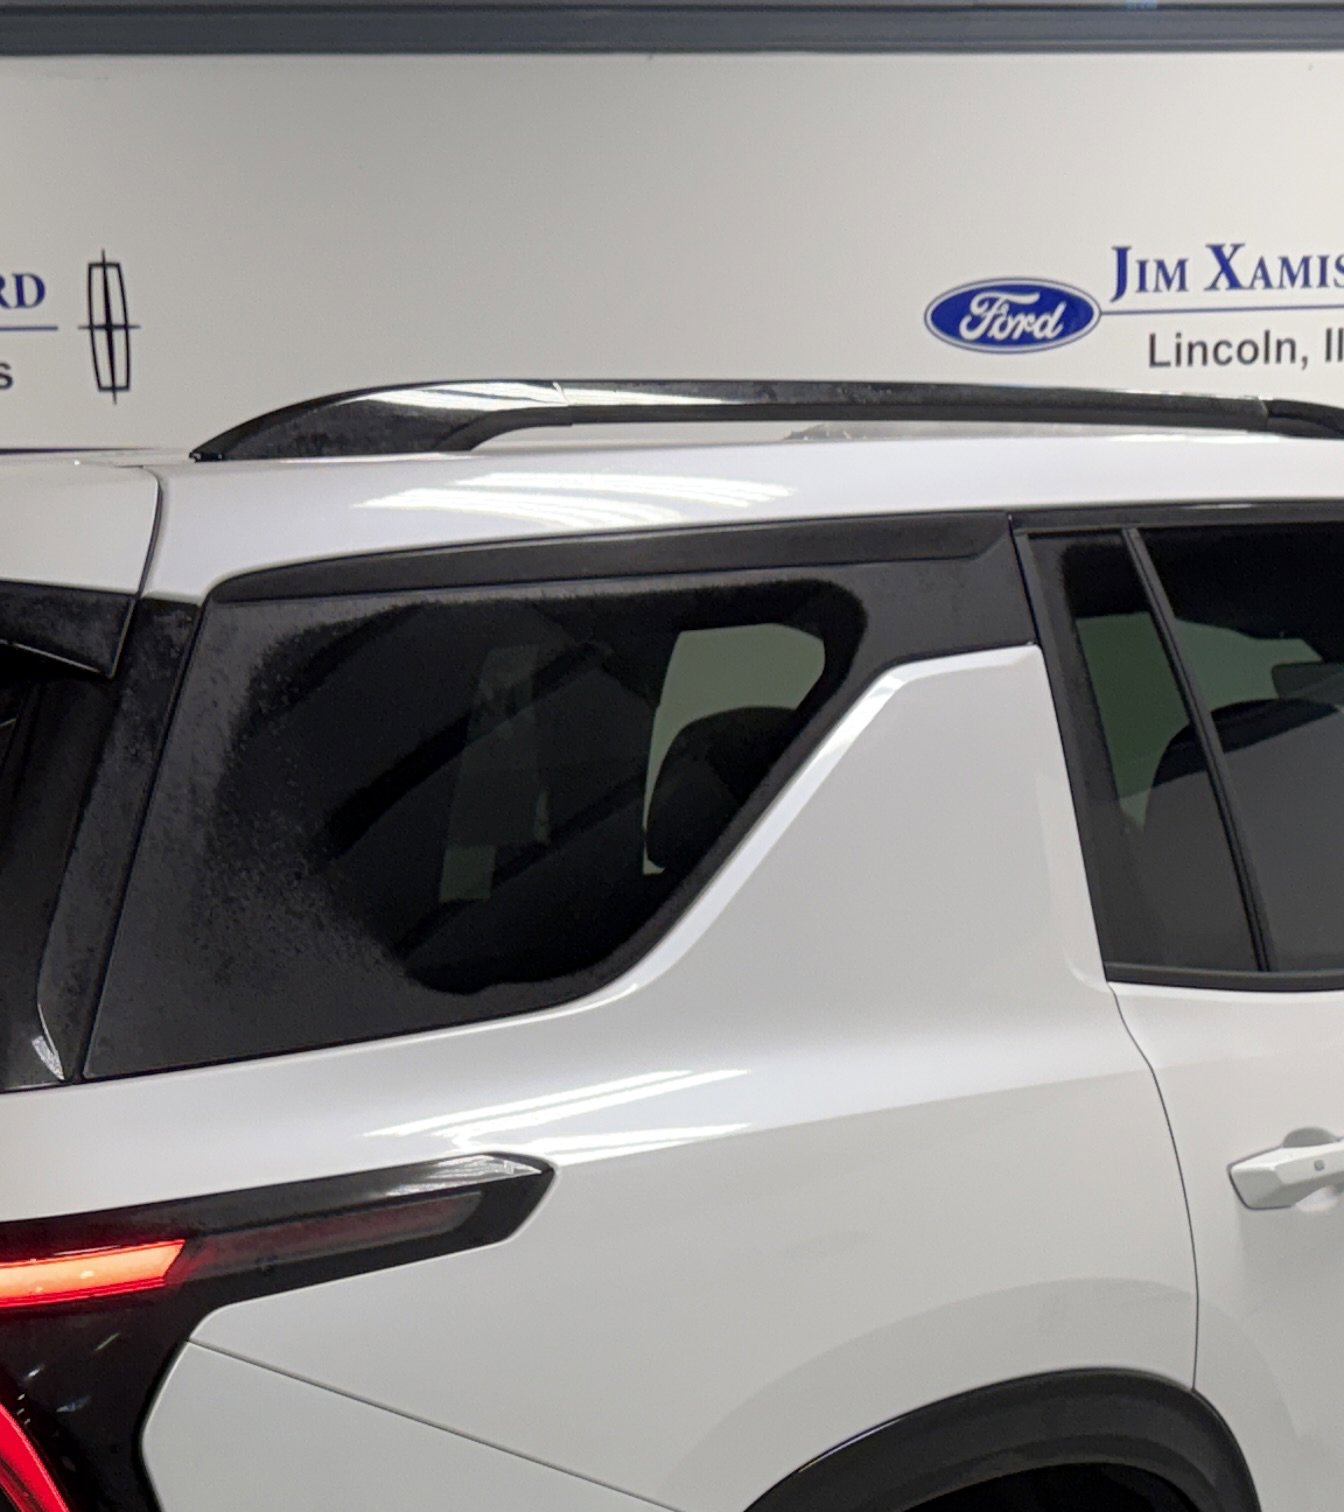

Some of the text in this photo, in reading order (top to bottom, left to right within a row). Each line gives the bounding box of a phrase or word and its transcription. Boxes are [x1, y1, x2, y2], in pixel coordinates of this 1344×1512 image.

[1109, 245, 1189, 303] JIM
[958, 290, 1065, 342] Ford
[1148, 329, 1309, 371] Lincoln,
